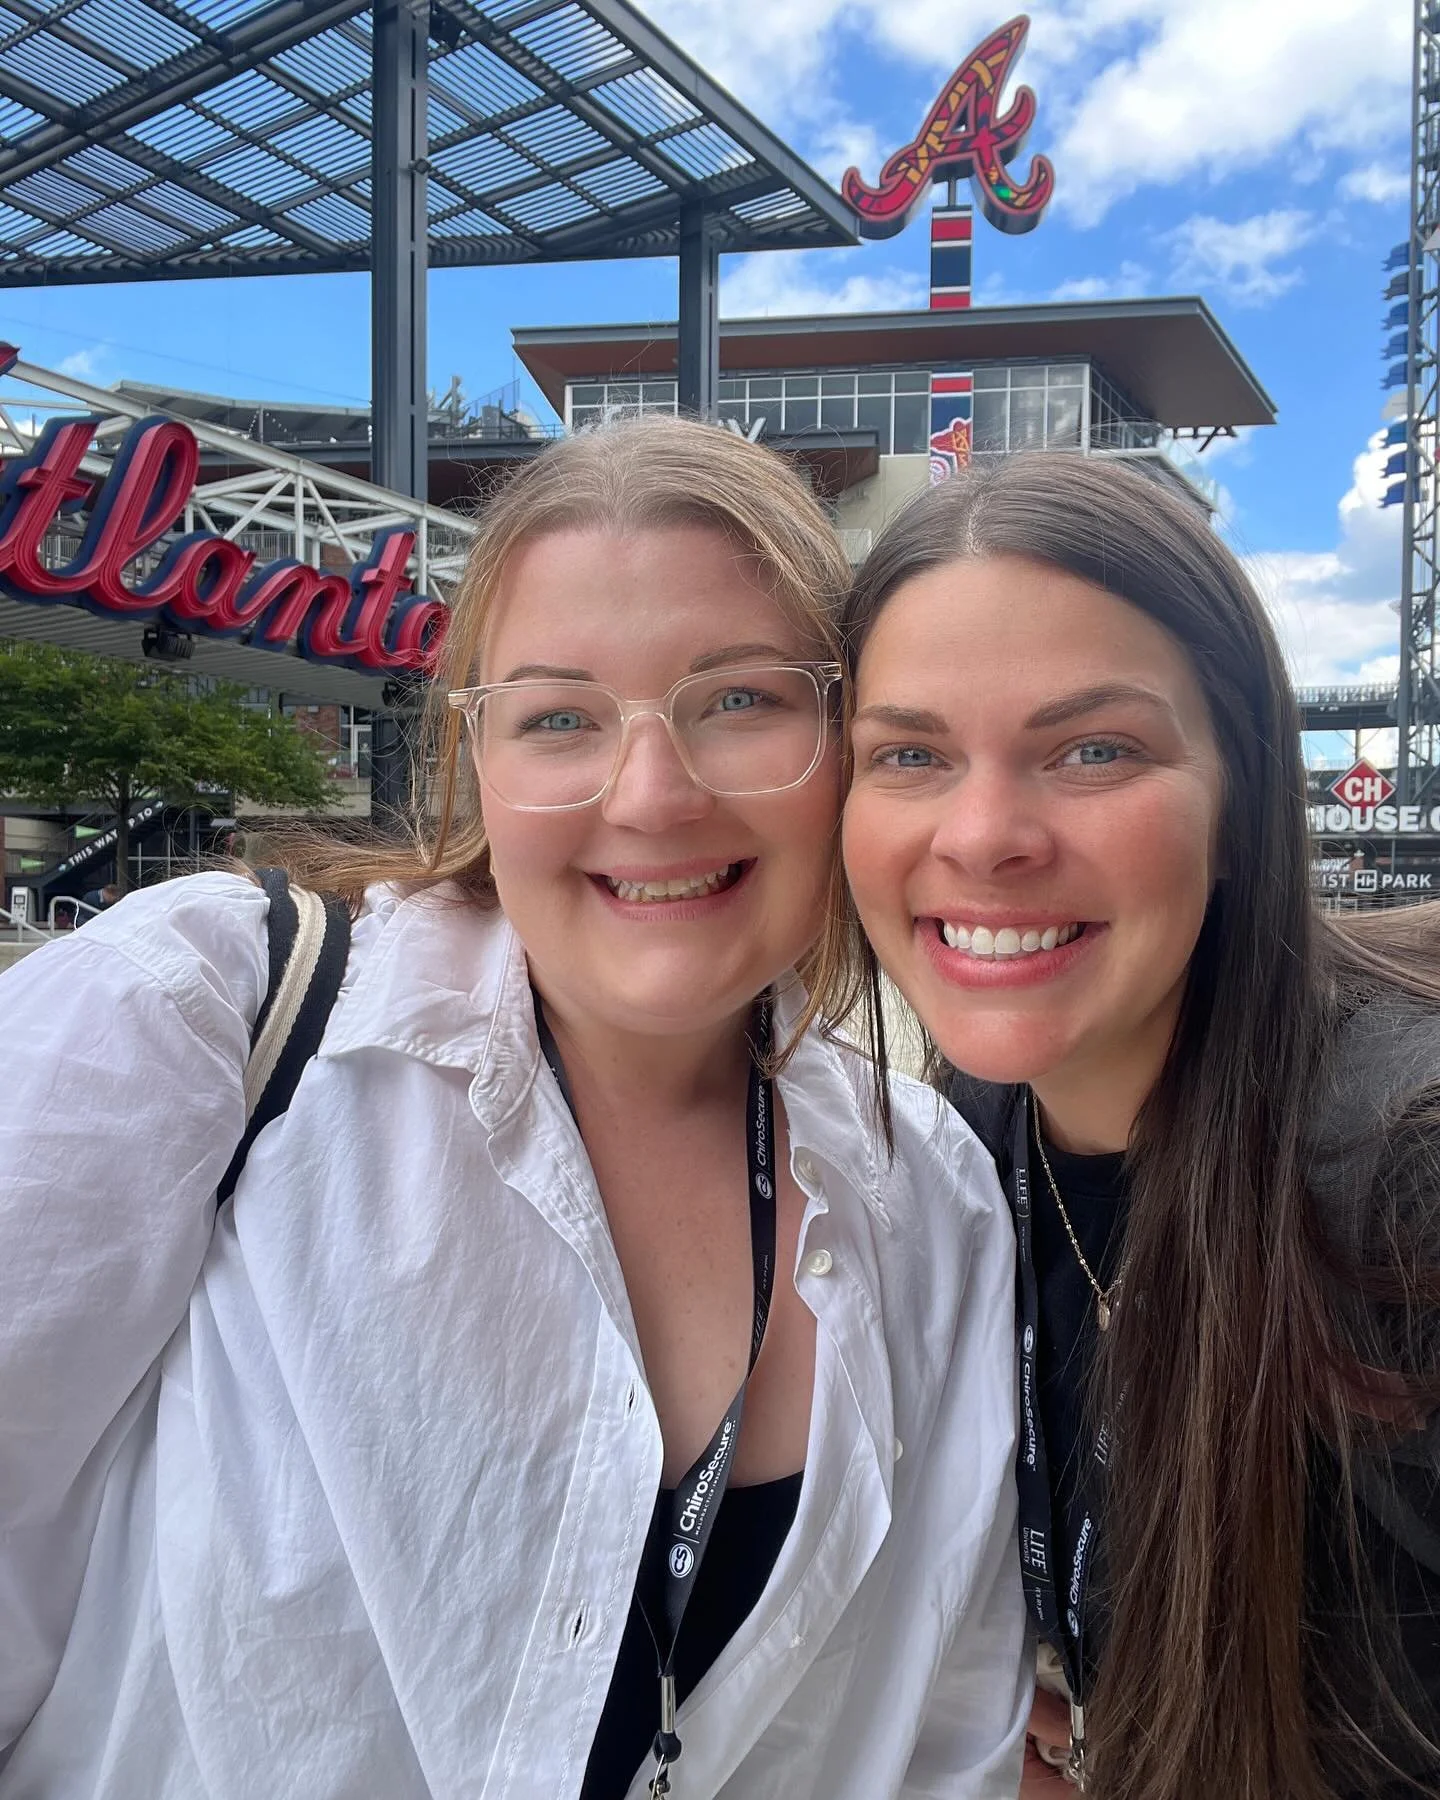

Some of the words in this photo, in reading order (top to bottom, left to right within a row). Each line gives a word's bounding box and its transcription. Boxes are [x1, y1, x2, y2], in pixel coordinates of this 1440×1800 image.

[0, 410, 453, 678] tlanta
[1344, 776, 1382, 802] CH
[68, 846, 93, 866] THIS
[94, 829, 118, 848] WAY
[137, 807, 153, 821] TO
[1321, 873, 1350, 888] IST
[1381, 873, 1433, 888] PARK
[1019, 1168, 1028, 1206] LIFE
[1023, 1362, 1037, 1466] ChiroSecure
[679, 1420, 733, 1532] ChiroSecure
[1030, 1529, 1046, 1574] LIFE
[1069, 1517, 1092, 1605] ChiroSecure
